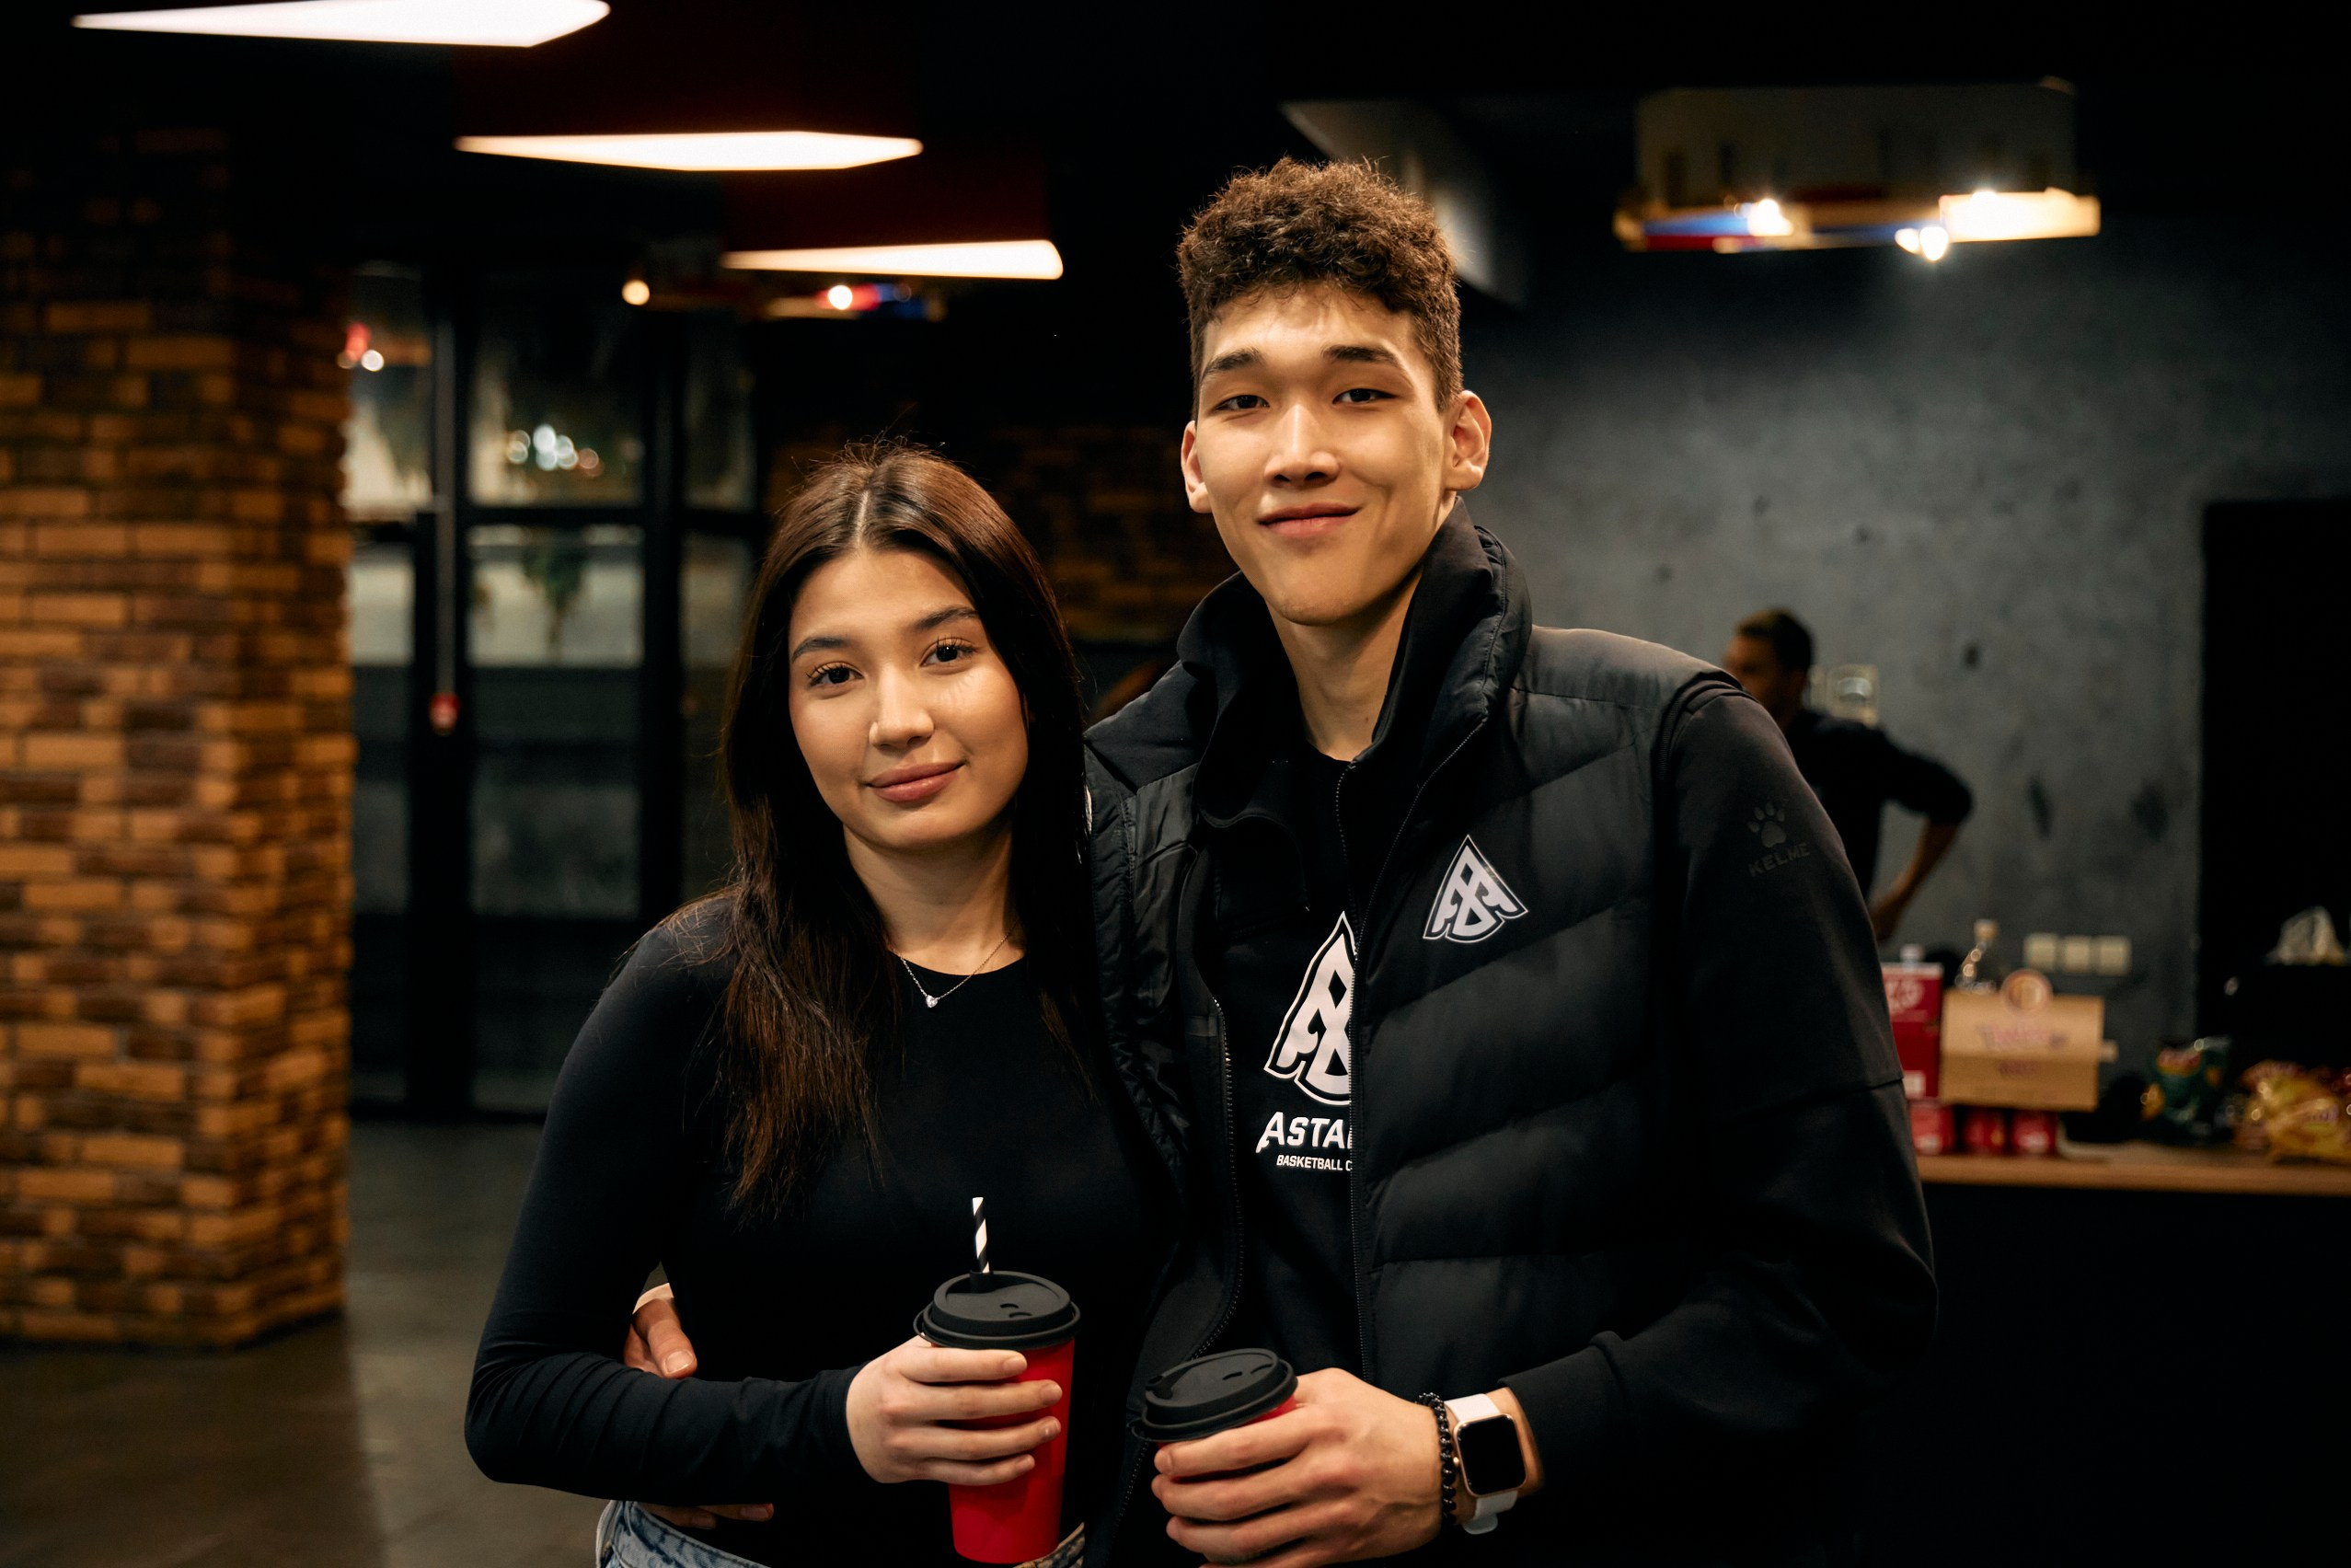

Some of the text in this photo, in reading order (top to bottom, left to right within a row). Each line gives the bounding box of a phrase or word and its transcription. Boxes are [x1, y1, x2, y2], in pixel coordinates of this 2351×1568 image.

[1748, 842, 1811, 877] KELME
[1255, 1111, 1353, 1154] ASTA
[1276, 1154, 1343, 1171] BASKETBALL
